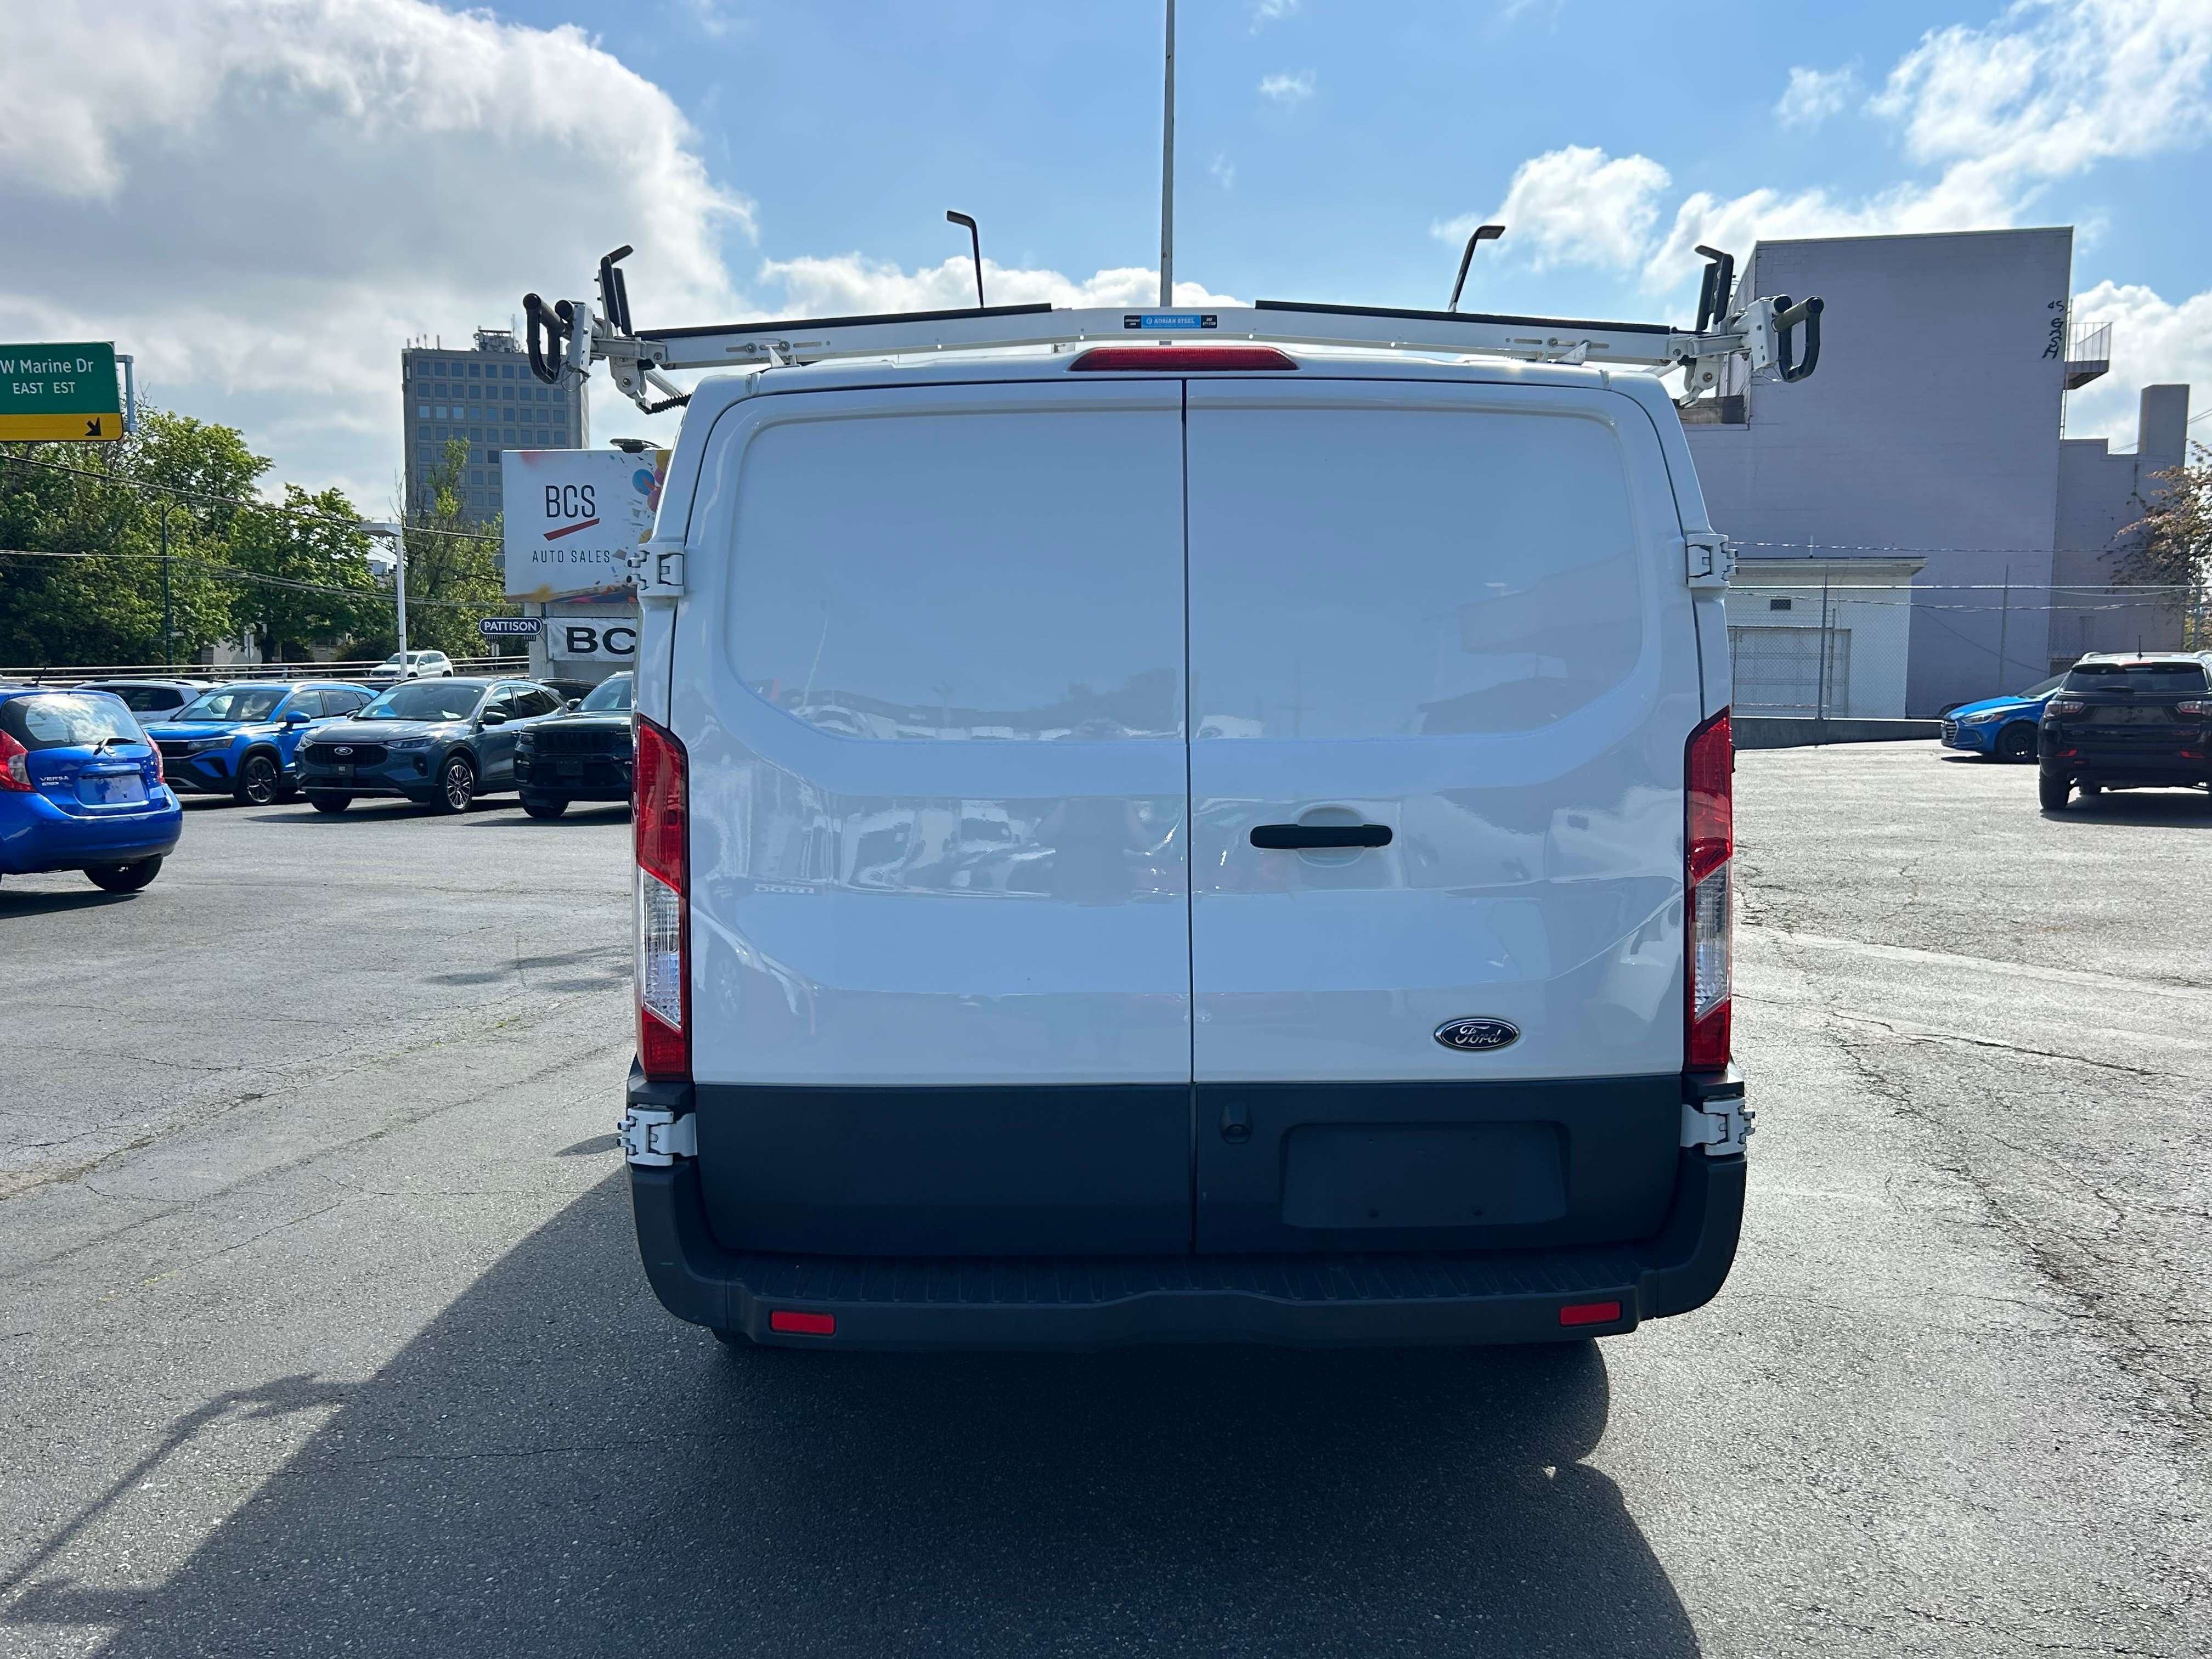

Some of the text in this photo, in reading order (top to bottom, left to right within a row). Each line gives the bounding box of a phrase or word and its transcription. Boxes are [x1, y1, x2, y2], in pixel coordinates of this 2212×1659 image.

[0, 358, 94, 374] W Marine Dr
[13, 382, 75, 394] EAST EST
[545, 484, 596, 518] BCS
[532, 550, 611, 563] AUTO SALES
[484, 621, 537, 631] PATTISON
[1455, 1025, 1502, 1044] Ford
